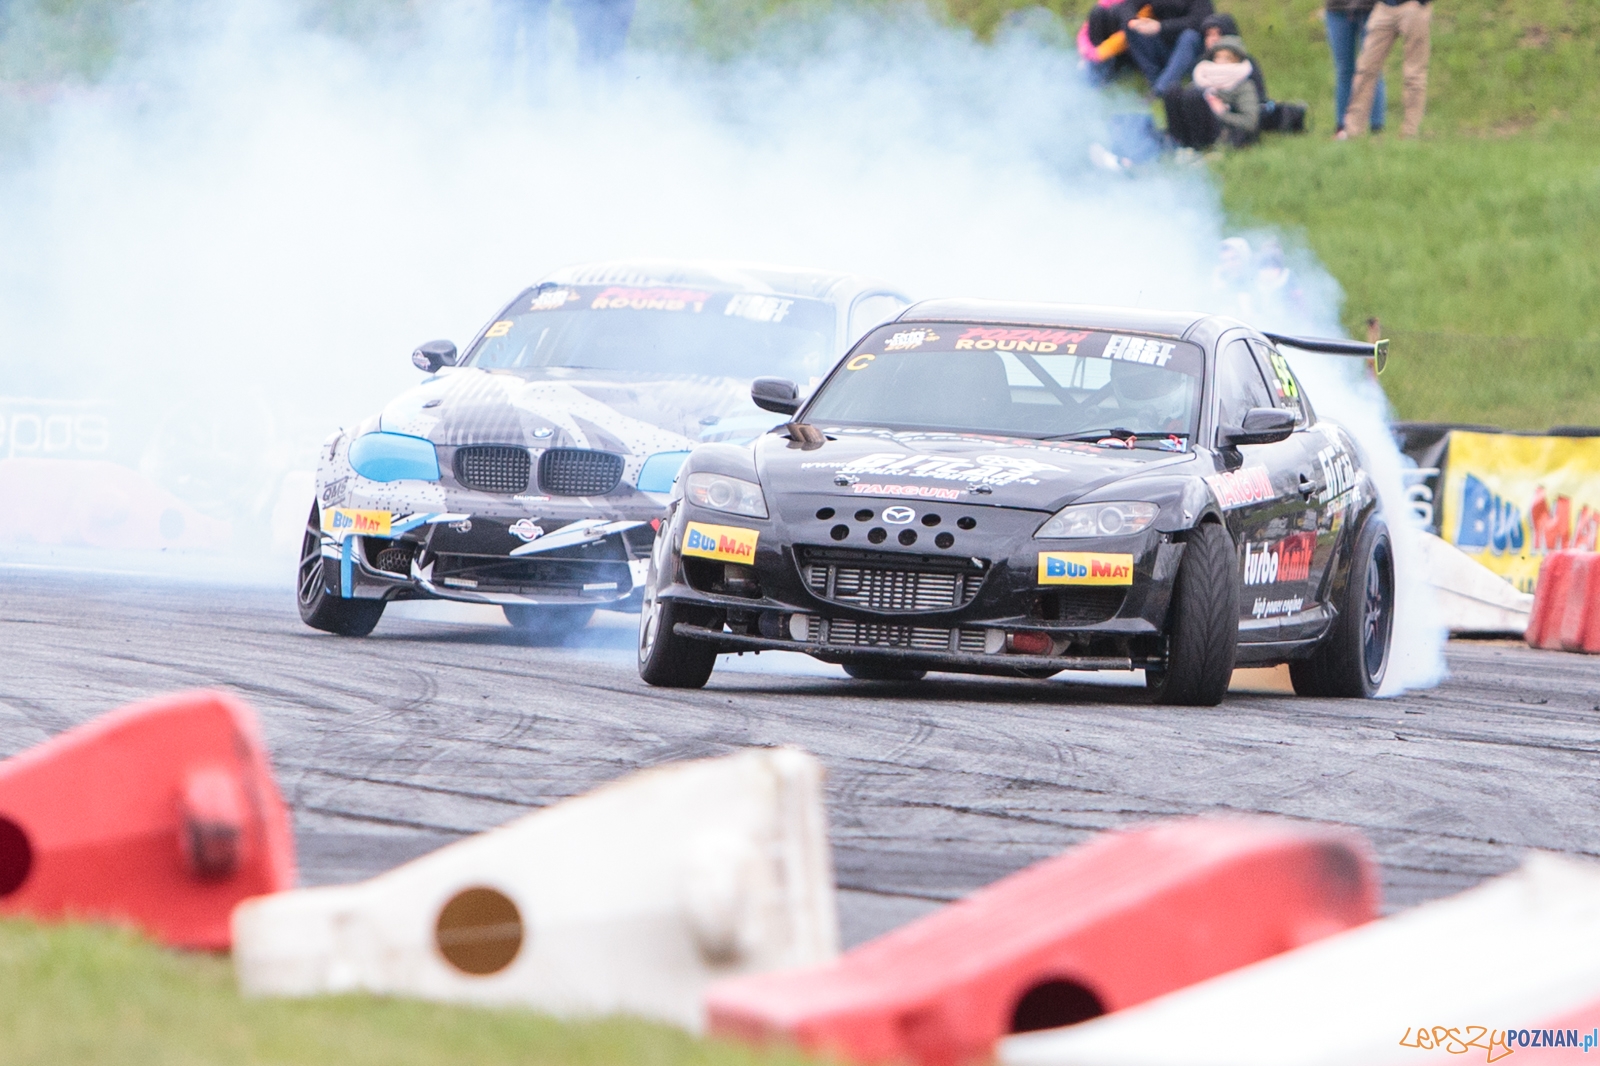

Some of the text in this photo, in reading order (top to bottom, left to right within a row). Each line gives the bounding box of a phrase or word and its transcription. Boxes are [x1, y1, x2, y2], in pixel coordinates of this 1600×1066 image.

[485, 320, 514, 338] B
[955, 339, 1078, 354] ROUND 1
[1107, 334, 1176, 354] FIRST
[846, 353, 876, 371] C
[1102, 345, 1173, 367] FIGHT
[852, 484, 960, 499] TARGUM
[1206, 466, 1275, 507] TARGUM
[1531, 485, 1600, 555] MA
